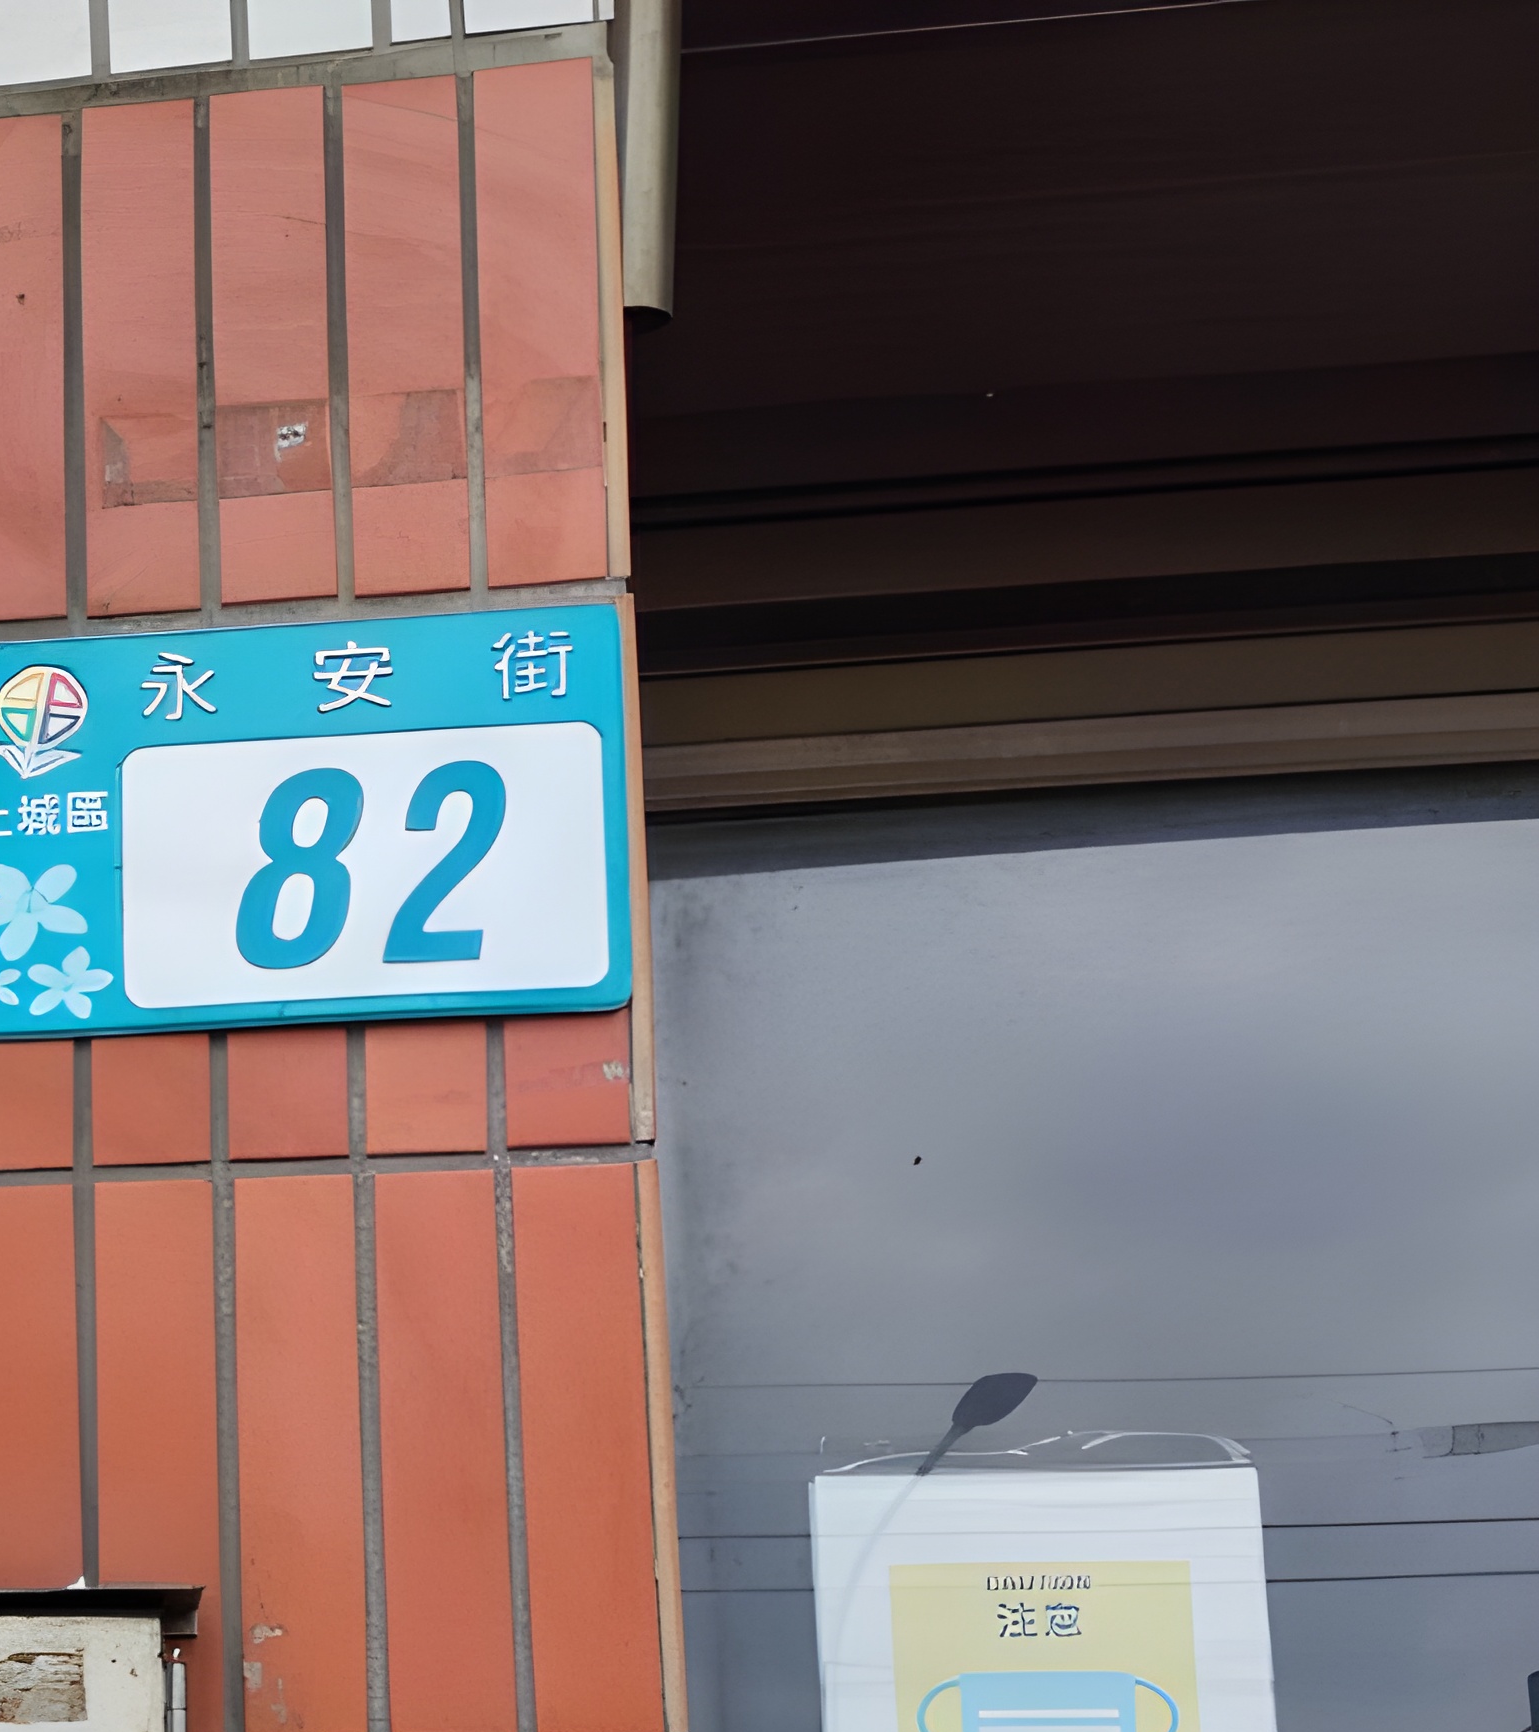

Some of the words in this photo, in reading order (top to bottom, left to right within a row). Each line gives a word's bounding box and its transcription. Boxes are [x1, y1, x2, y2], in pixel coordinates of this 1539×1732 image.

[140, 630, 575, 721] 永安街
[235, 759, 507, 970] 82
